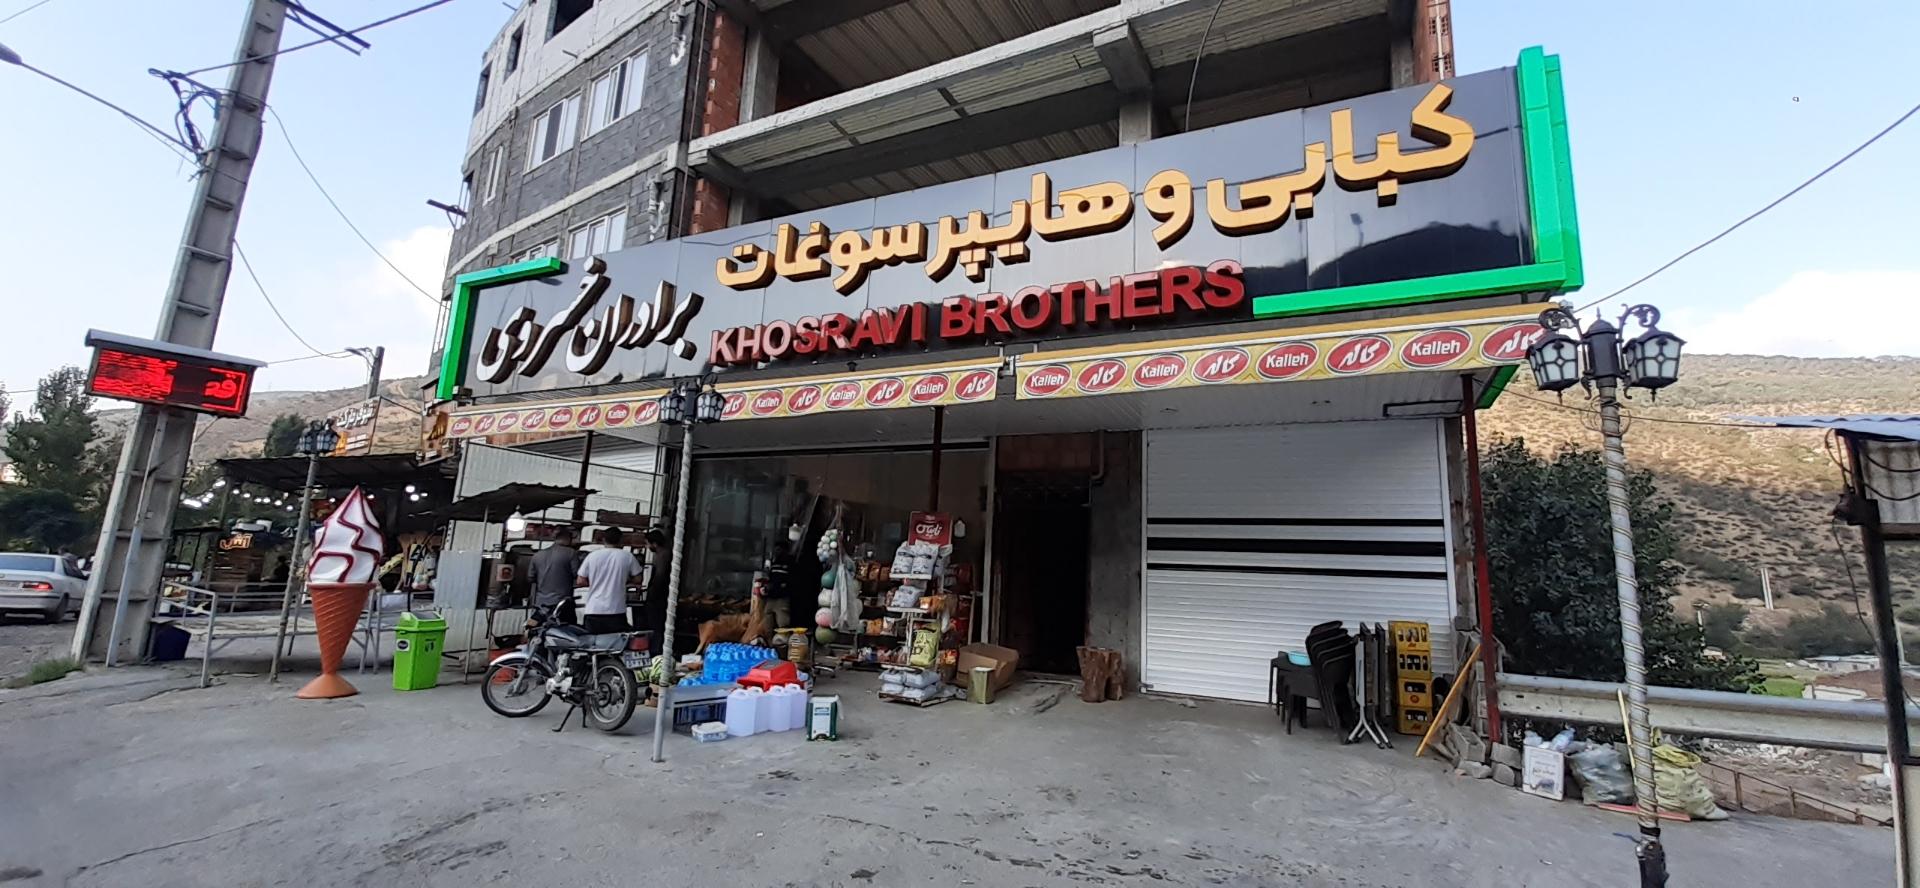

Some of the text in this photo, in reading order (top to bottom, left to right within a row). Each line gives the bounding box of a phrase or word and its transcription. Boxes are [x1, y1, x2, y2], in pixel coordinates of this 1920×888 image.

[715, 82, 1476, 297] کبابی و هایپر سوغات
[476, 255, 704, 385] برادران خسروی
[709, 258, 1246, 366] KHOSRAVI BROTHERS
[1265, 350, 1309, 369] Kalleh
[1338, 340, 1382, 370] کاله
[1411, 338, 1461, 357] Kalleh
[1086, 364, 1120, 388] کاله
[1141, 363, 1178, 379] Kalleh
[1202, 353, 1241, 378] کاله
[914, 382, 944, 396] Kalleh
[1030, 374, 1065, 388] Kalleh
